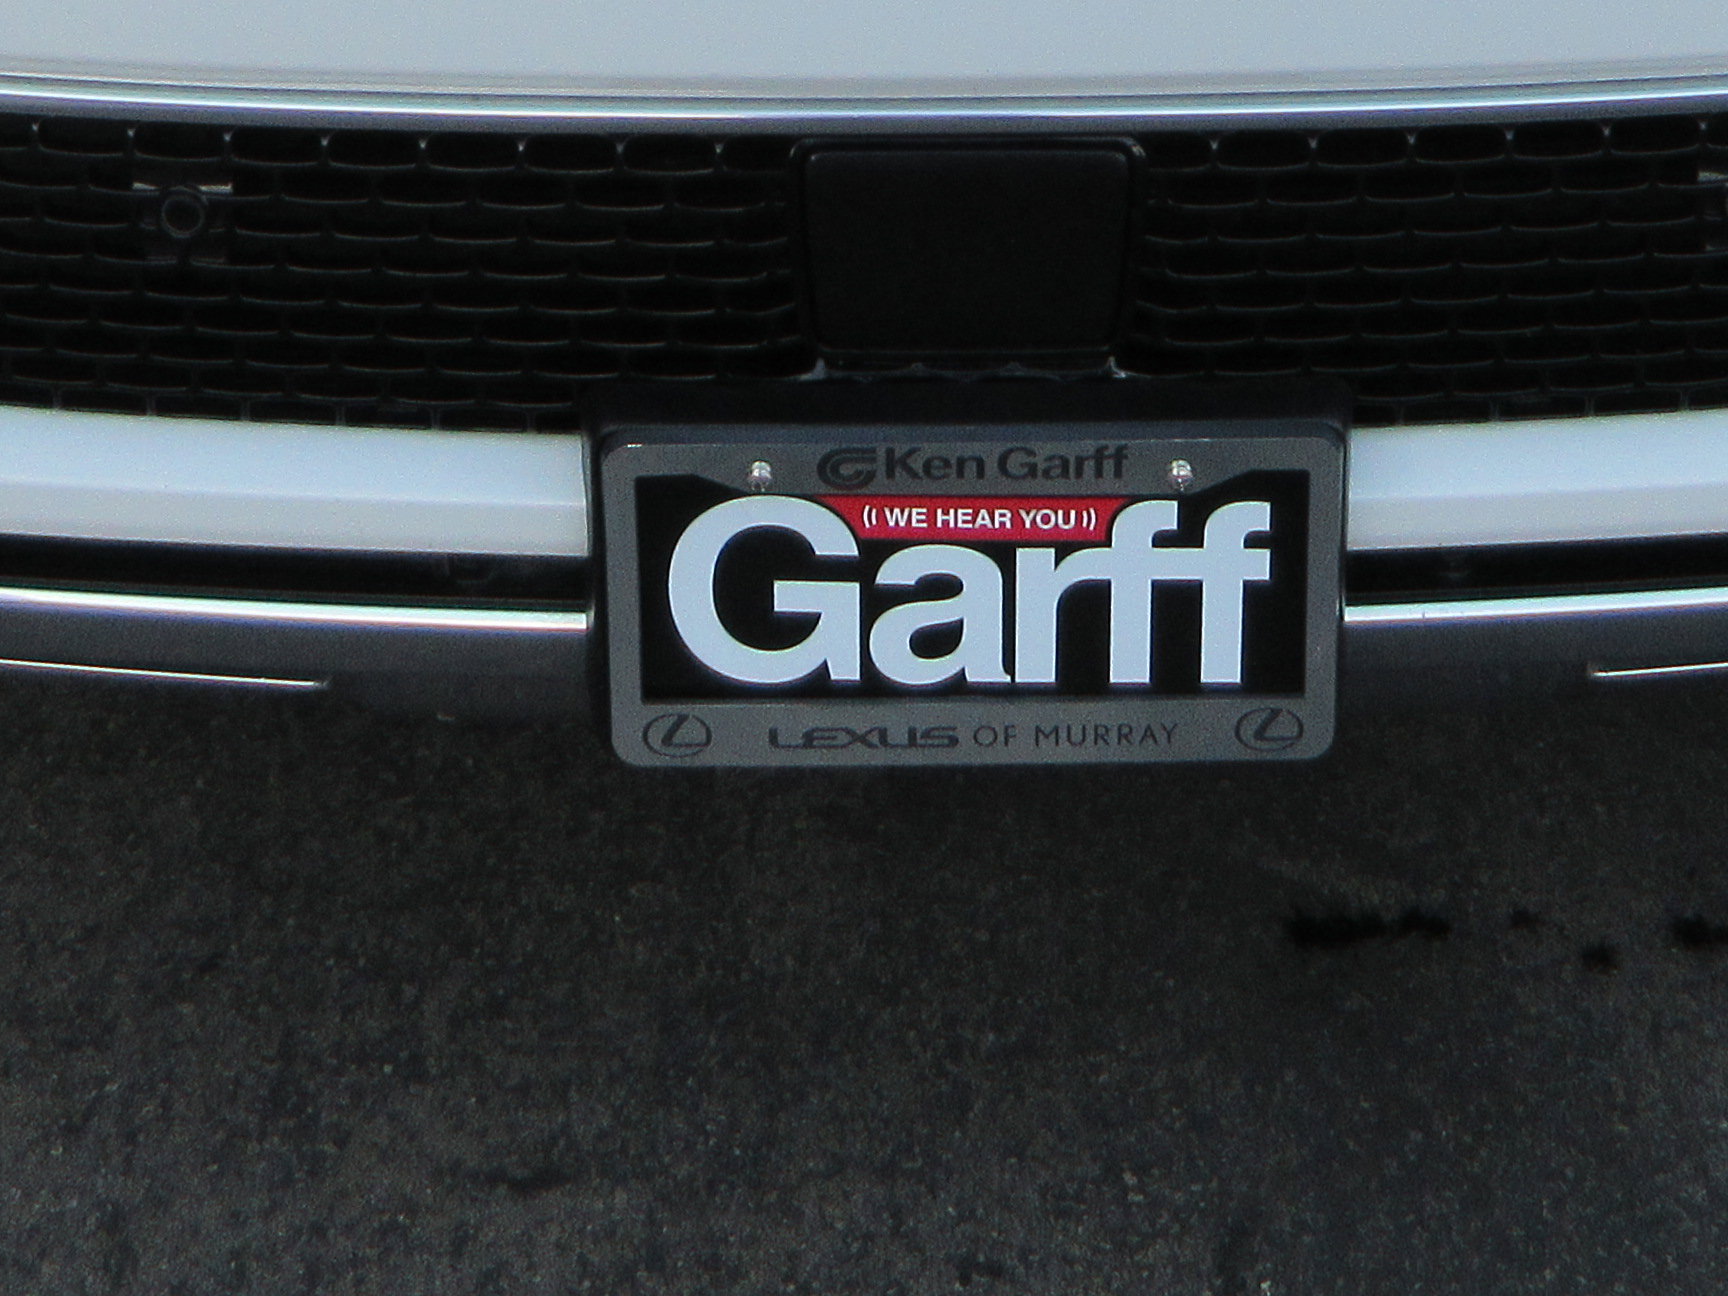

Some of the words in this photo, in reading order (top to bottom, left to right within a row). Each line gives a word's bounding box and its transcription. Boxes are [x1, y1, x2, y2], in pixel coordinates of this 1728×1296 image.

[884, 446, 985, 481] Ken
[997, 444, 1128, 481] Garff
[884, 507, 928, 529] WE
[936, 508, 1012, 530] HEAR
[1019, 509, 1076, 531] YOU
[668, 494, 1271, 686] Garff
[768, 725, 960, 750] LEXUS
[973, 724, 1016, 747] OF
[1034, 723, 1179, 748] MURRAY
